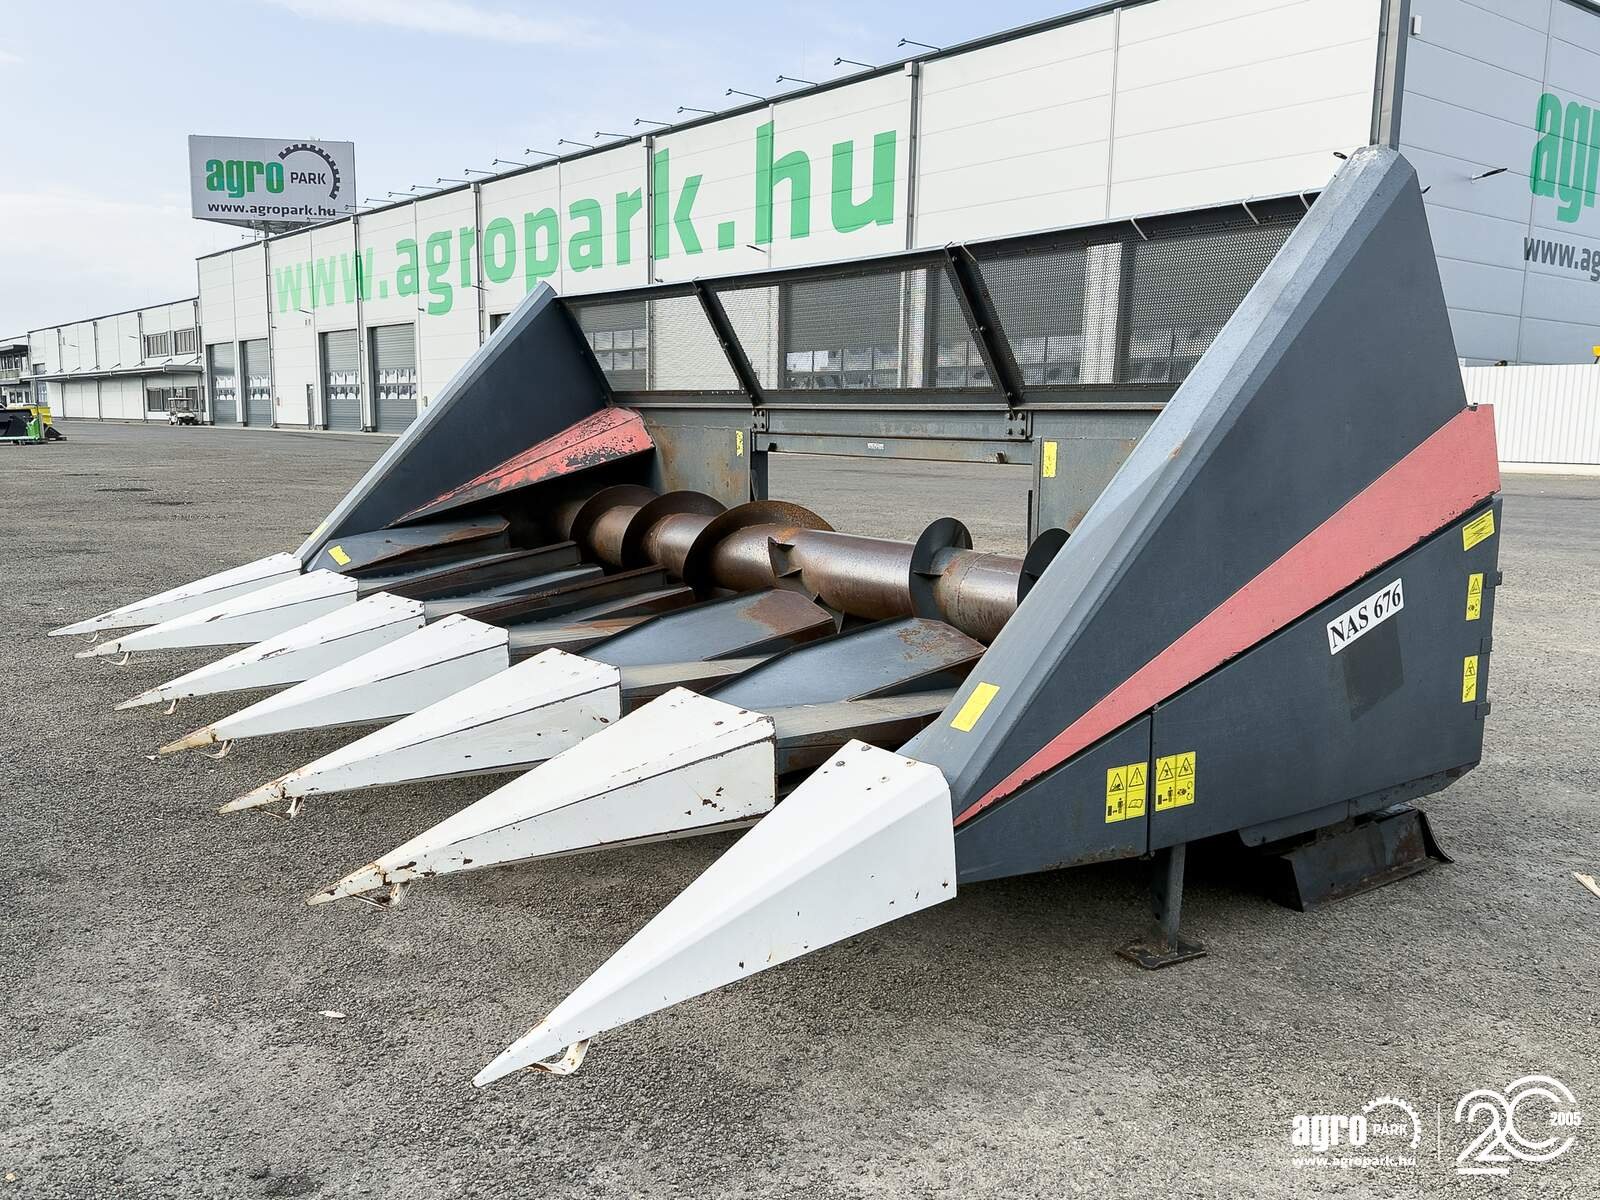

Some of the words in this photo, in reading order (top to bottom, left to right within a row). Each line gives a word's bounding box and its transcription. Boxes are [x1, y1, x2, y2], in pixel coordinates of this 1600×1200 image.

[206, 159, 285, 198] agro
[290, 171, 326, 185] PARK
[207, 203, 336, 217] www.agropark.hu
[275, 120, 897, 317] www.agropark.hu
[1330, 606, 1369, 648] NAS
[1374, 583, 1401, 618] 676
